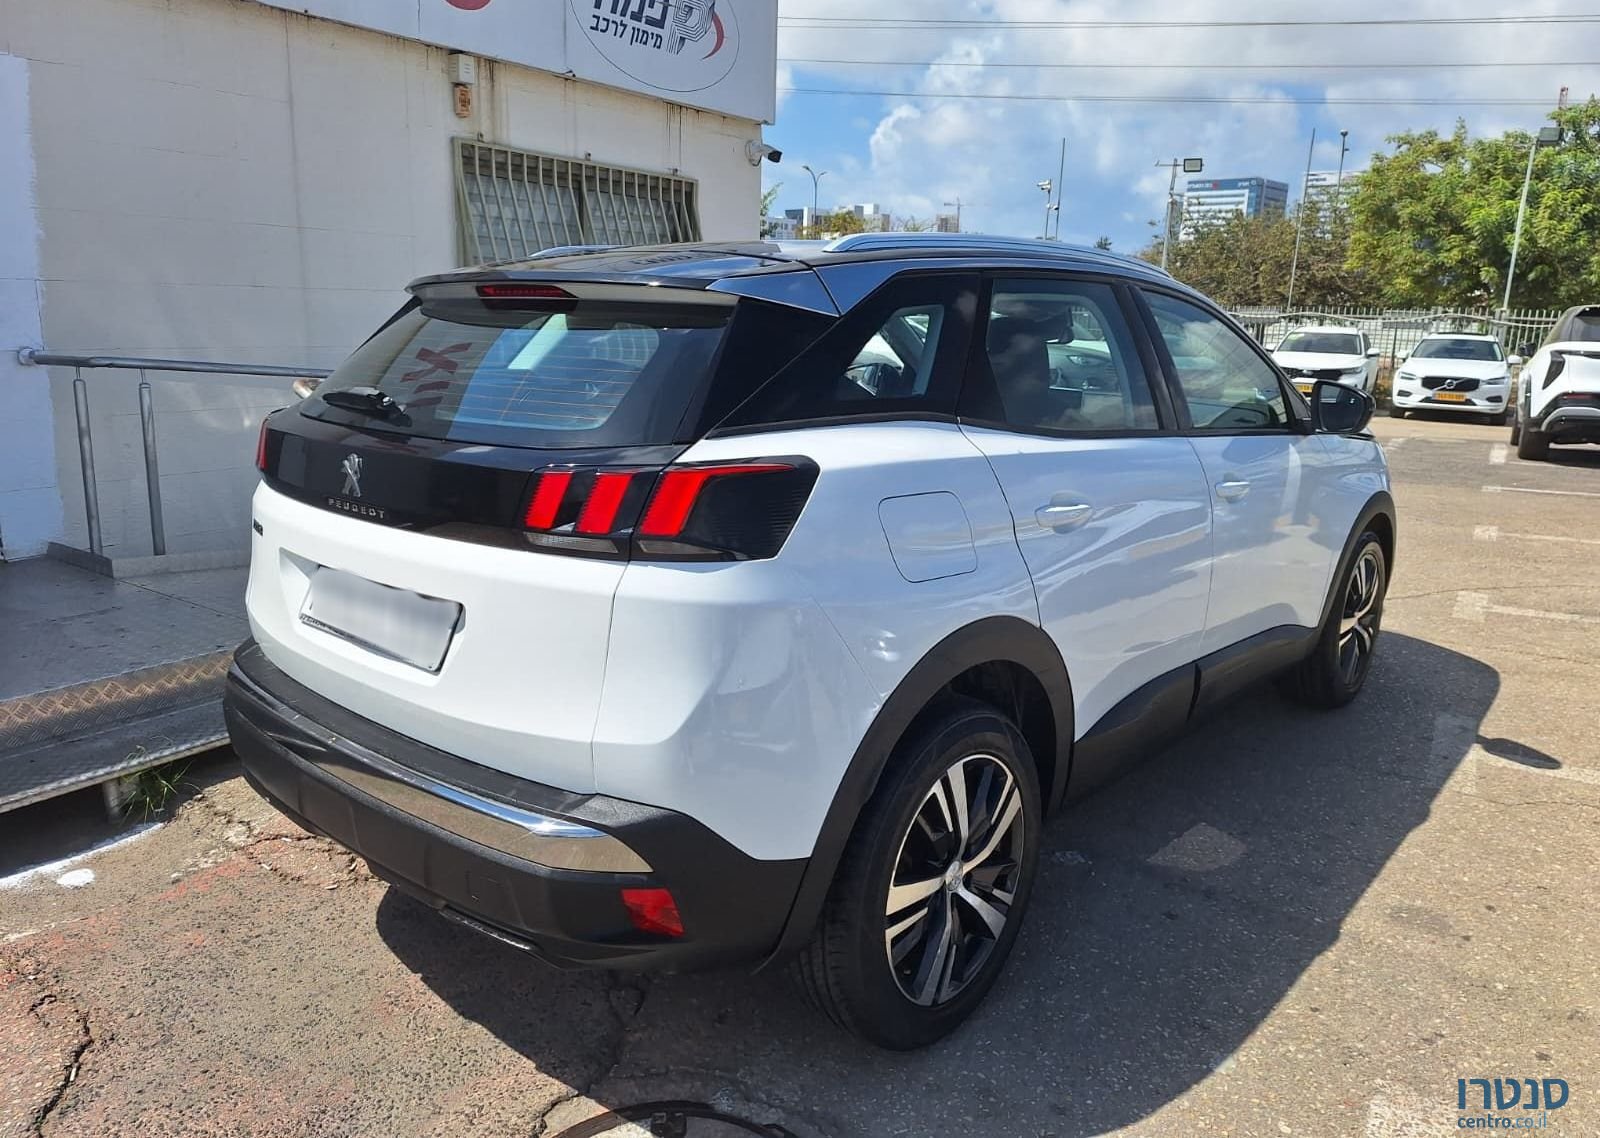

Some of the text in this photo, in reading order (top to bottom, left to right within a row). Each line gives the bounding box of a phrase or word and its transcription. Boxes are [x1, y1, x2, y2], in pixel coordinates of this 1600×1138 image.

[589, 14, 663, 50] מימון לרכב
[328, 498, 385, 519] PEUGEOT
